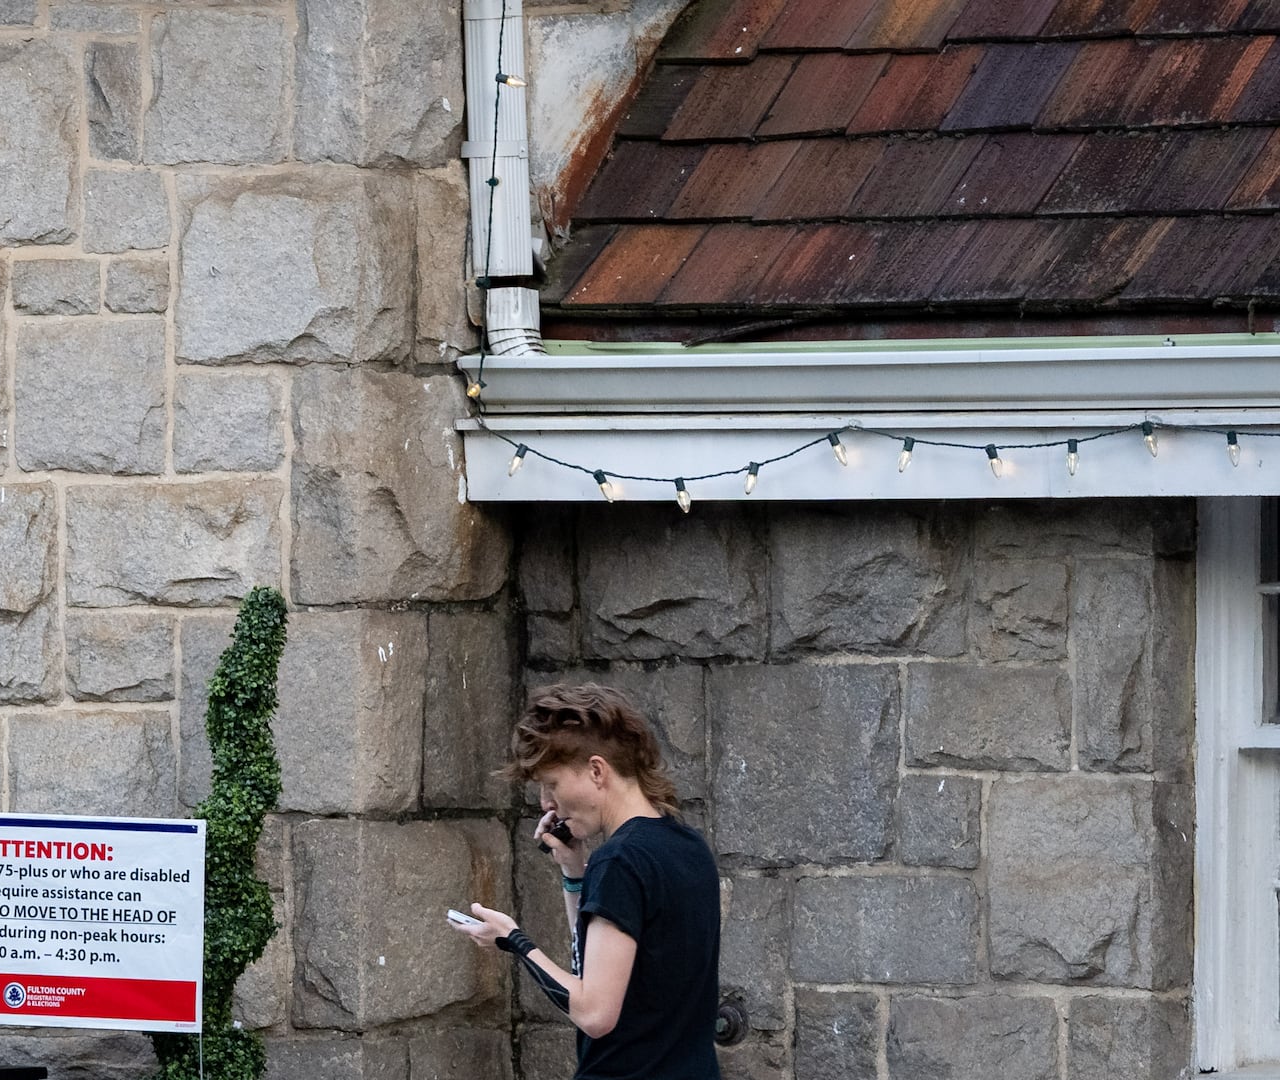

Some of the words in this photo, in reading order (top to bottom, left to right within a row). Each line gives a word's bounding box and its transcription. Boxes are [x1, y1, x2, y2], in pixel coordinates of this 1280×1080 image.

[52, 868, 67, 879] or
[70, 866, 100, 880] who
[104, 870, 127, 881] are
[130, 868, 190, 883] disabled
[42, 887, 114, 901] assistance
[117, 890, 142, 902] can
[14, 905, 57, 919] MOVE
[60, 907, 78, 920] TO
[81, 908, 109, 921] THE
[112, 909, 153, 922] HEAD
[157, 911, 177, 923] OF
[50, 929, 118, 944] non-peak
[121, 929, 166, 944] hours:
[10, 949, 41, 960] a.m.
[55, 948, 86, 961] 4:30
[90, 951, 120, 965] p.m.
[26, 985, 56, 995] FULTON
[56, 987, 86, 996] COUNTY
[26, 995, 66, 1003] REGISTRATION
